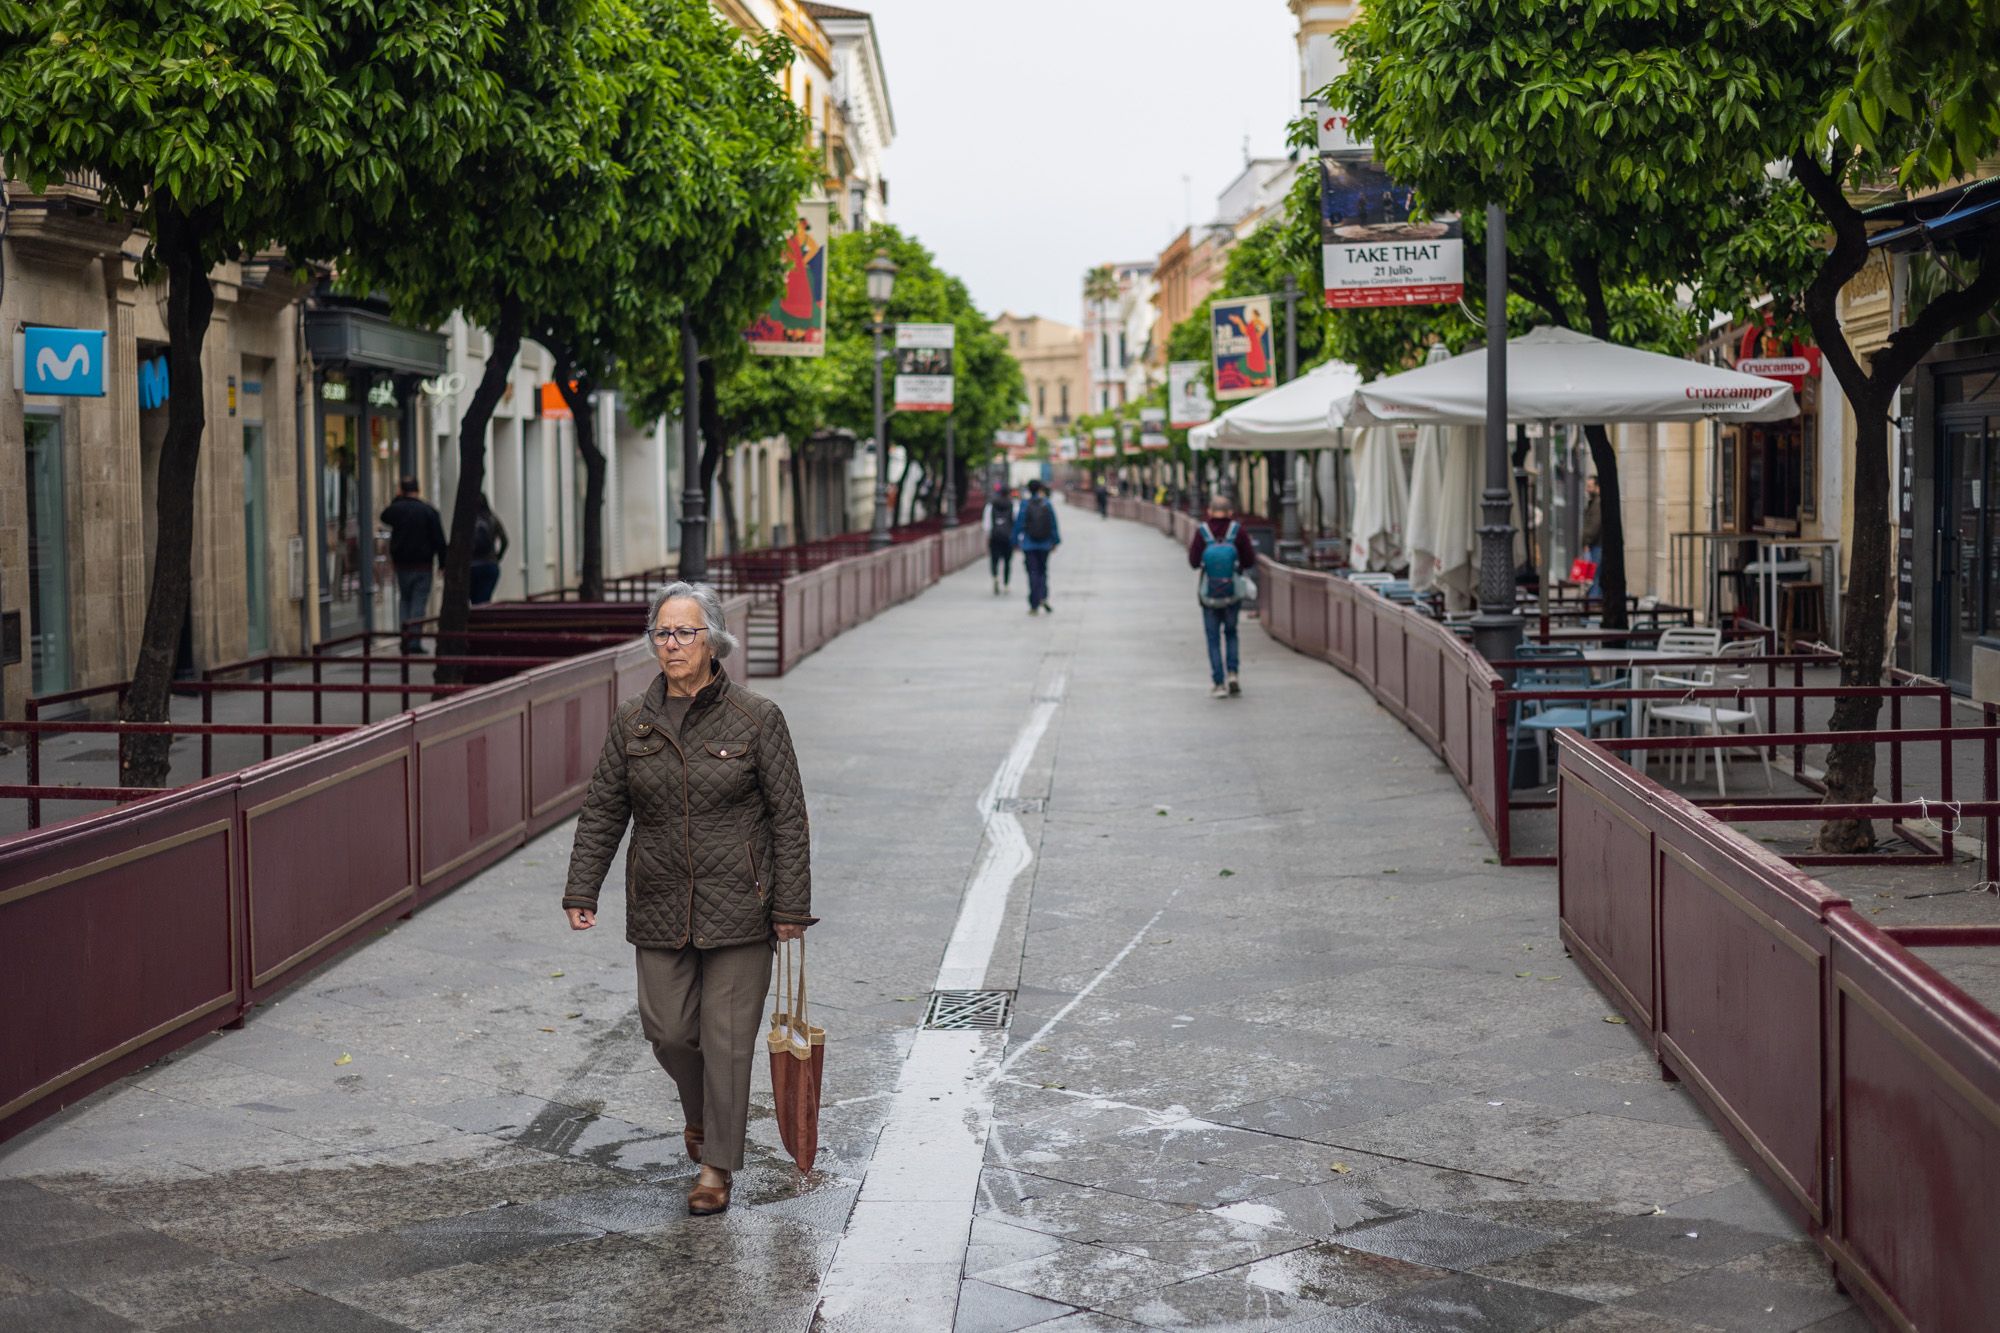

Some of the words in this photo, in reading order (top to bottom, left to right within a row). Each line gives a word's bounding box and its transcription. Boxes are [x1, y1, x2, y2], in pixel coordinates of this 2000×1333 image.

[1345, 247, 1388, 263] TAKE
[1392, 245, 1440, 261] THAT
[1374, 266, 1385, 276] 21
[1388, 265, 1413, 276] Julio
[1742, 362, 1805, 374] Cruzcampo
[1685, 386, 1773, 400] Cruzcampo
[1702, 402, 1751, 410] ESPECIAL
